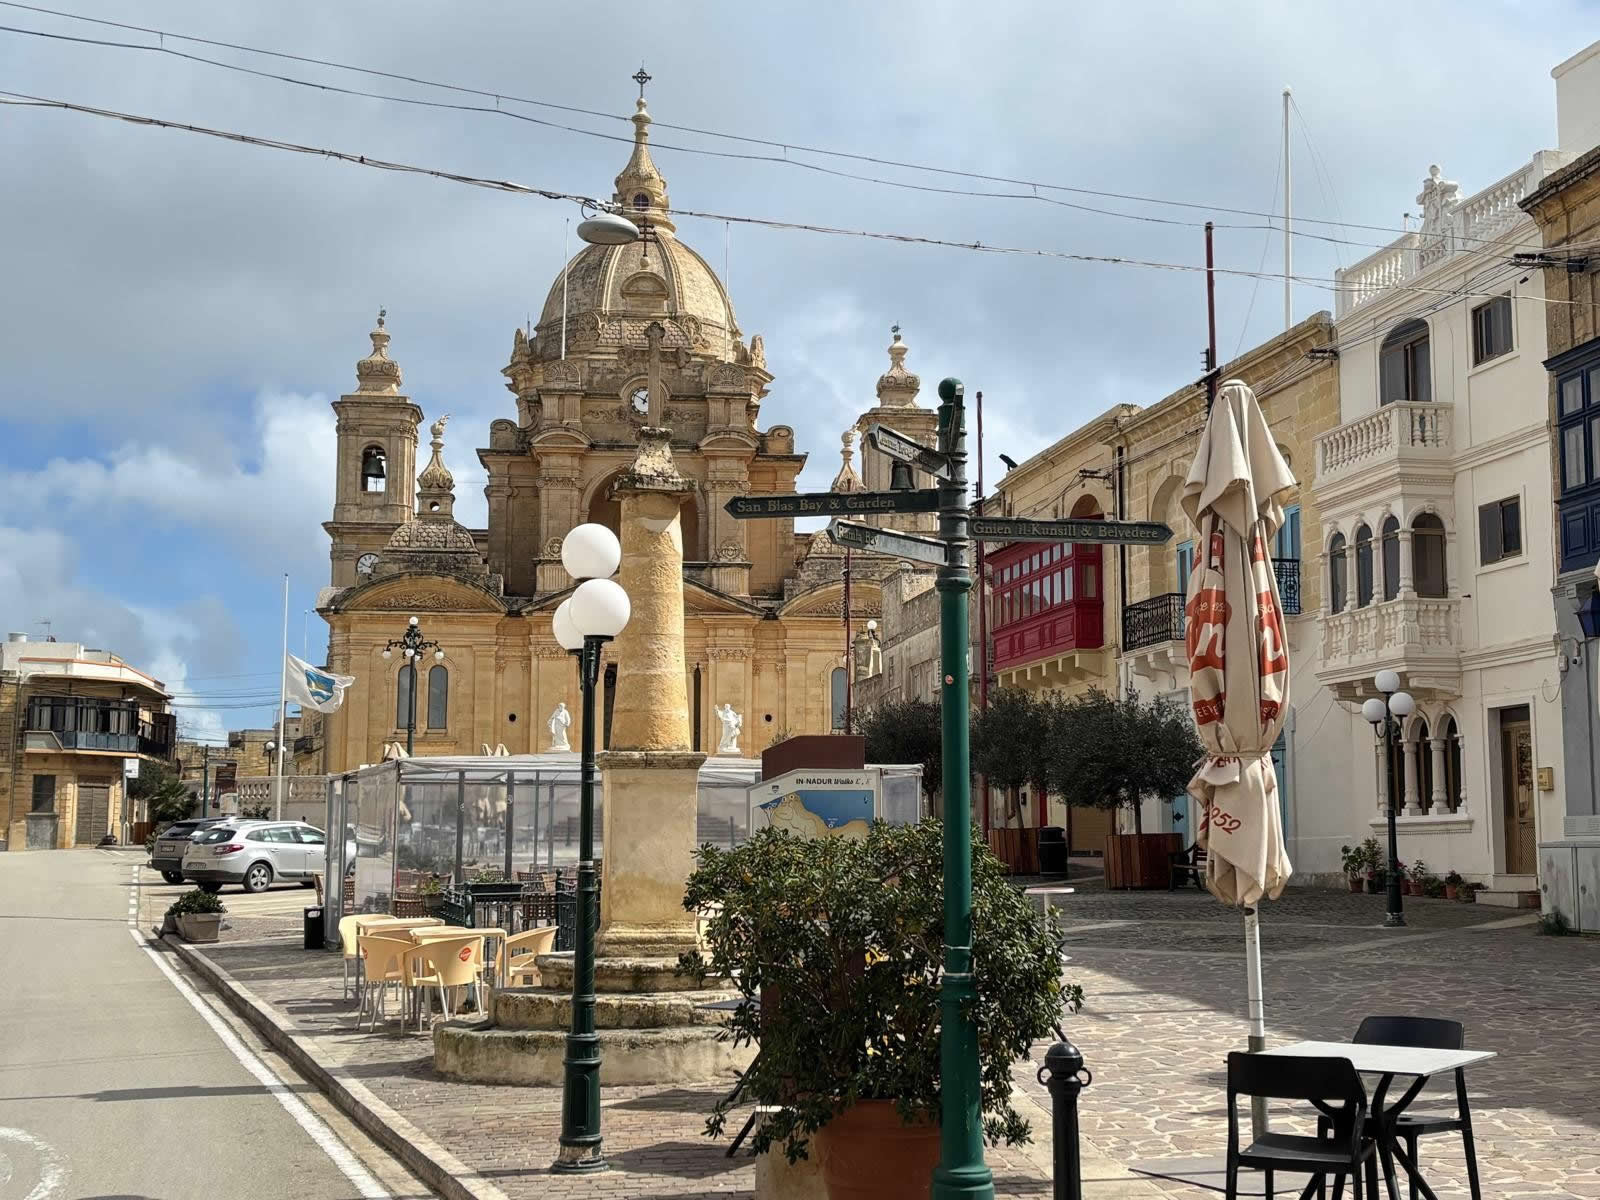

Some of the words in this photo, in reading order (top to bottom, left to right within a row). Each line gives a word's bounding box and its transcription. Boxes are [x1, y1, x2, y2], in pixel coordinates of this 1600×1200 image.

[736, 499, 762, 513] San
[767, 498, 794, 513] Blas
[800, 498, 824, 513] Bay
[829, 498, 840, 510] &
[846, 496, 896, 510] Garden
[865, 530, 879, 549] Bay
[1017, 523, 1076, 538] il-Kunsill
[1080, 525, 1093, 537] &
[1098, 525, 1158, 539] Belvedere
